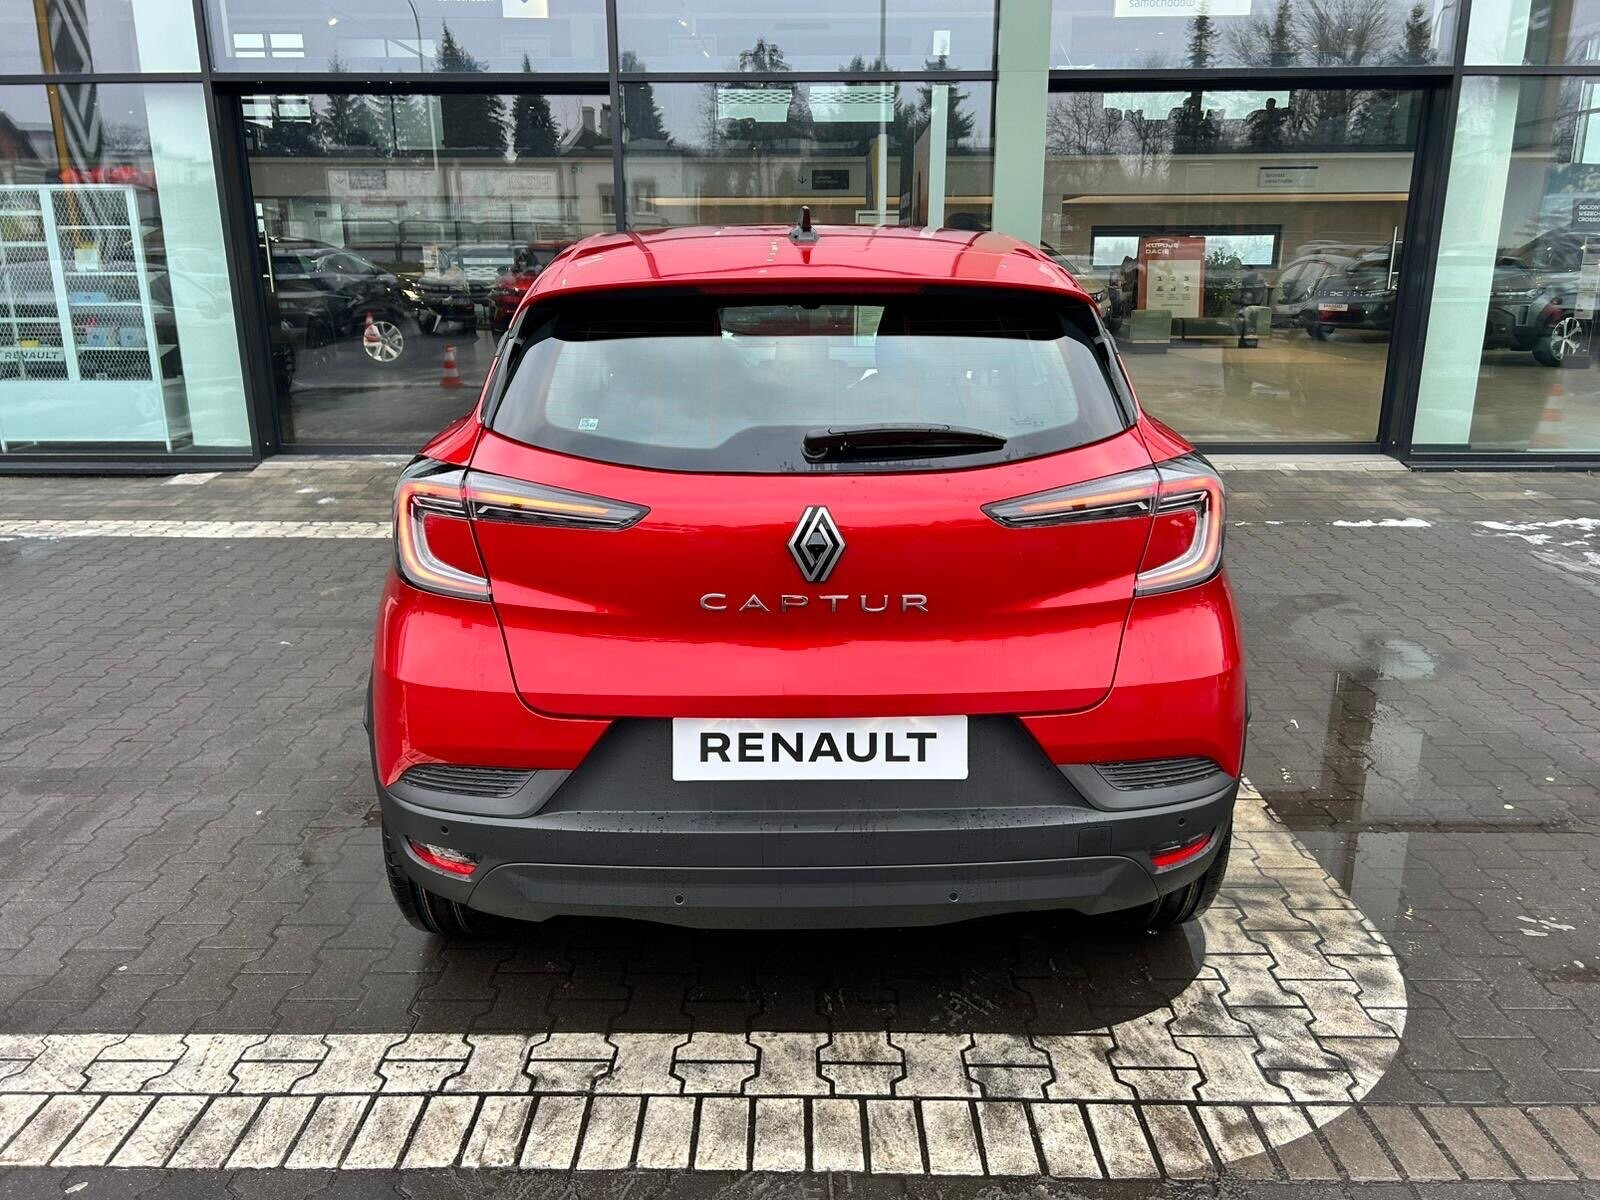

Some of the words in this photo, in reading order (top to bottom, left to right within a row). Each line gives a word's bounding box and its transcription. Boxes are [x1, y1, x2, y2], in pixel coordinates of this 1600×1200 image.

[4, 351, 59, 360] RENAULT
[699, 592, 929, 613] CAPTUR
[699, 731, 938, 763] RENAULT
